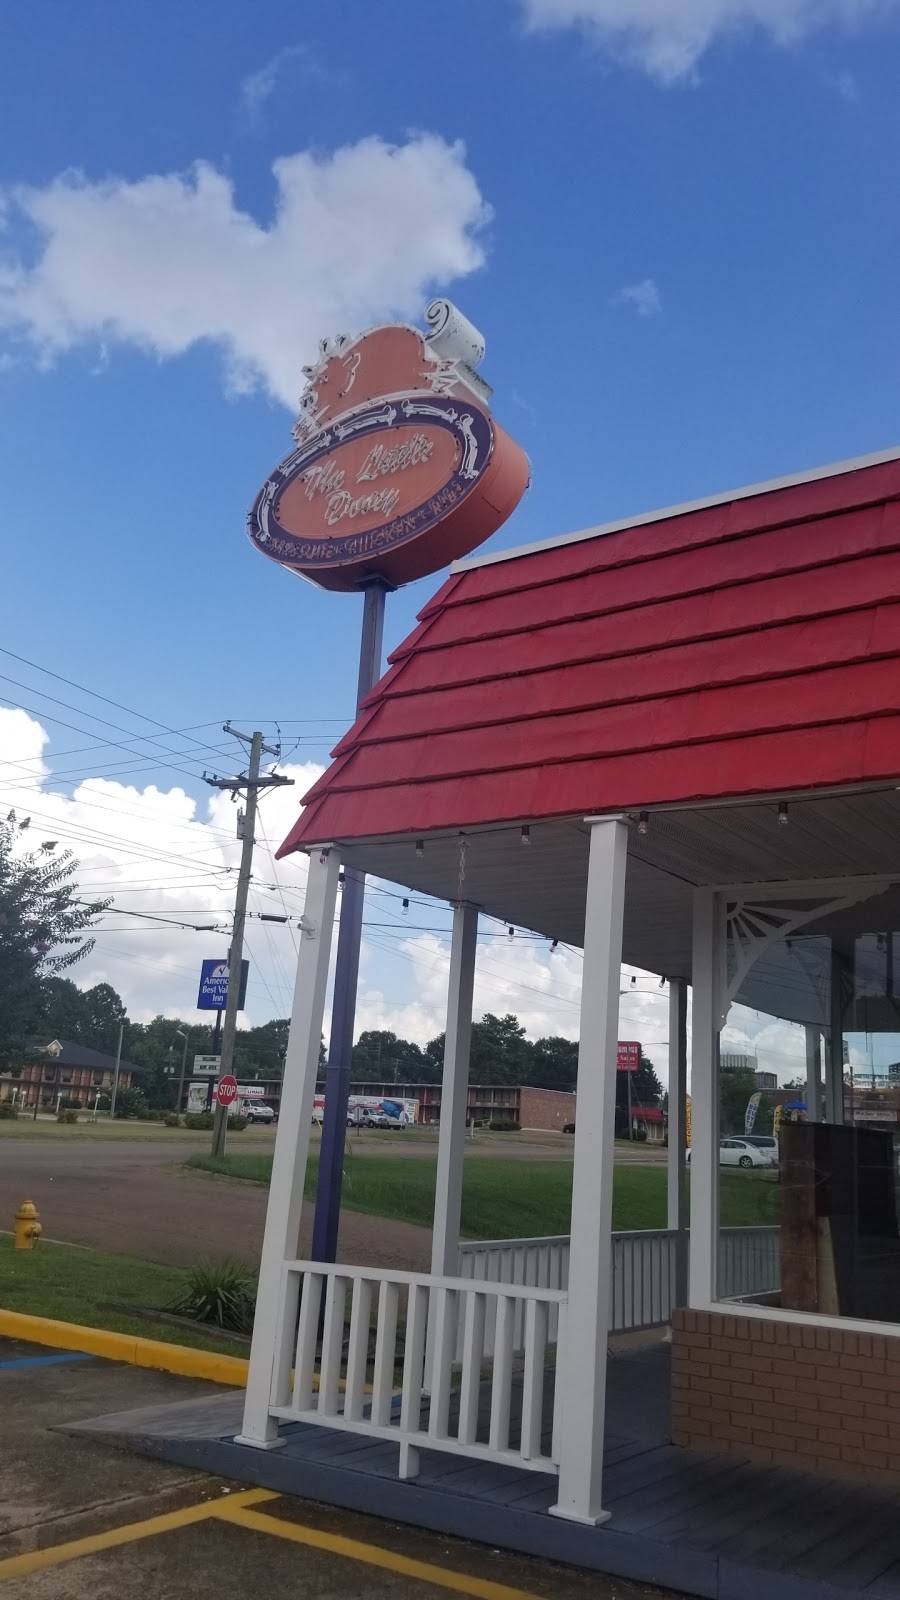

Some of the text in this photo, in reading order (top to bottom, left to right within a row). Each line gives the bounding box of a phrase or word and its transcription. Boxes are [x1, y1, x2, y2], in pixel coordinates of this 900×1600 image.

[301, 459, 345, 501] The
[204, 977, 230, 985] Americ
[202, 985, 229, 994] Best Val
[212, 993, 224, 1002] Inn
[219, 1083, 236, 1096] STOP
